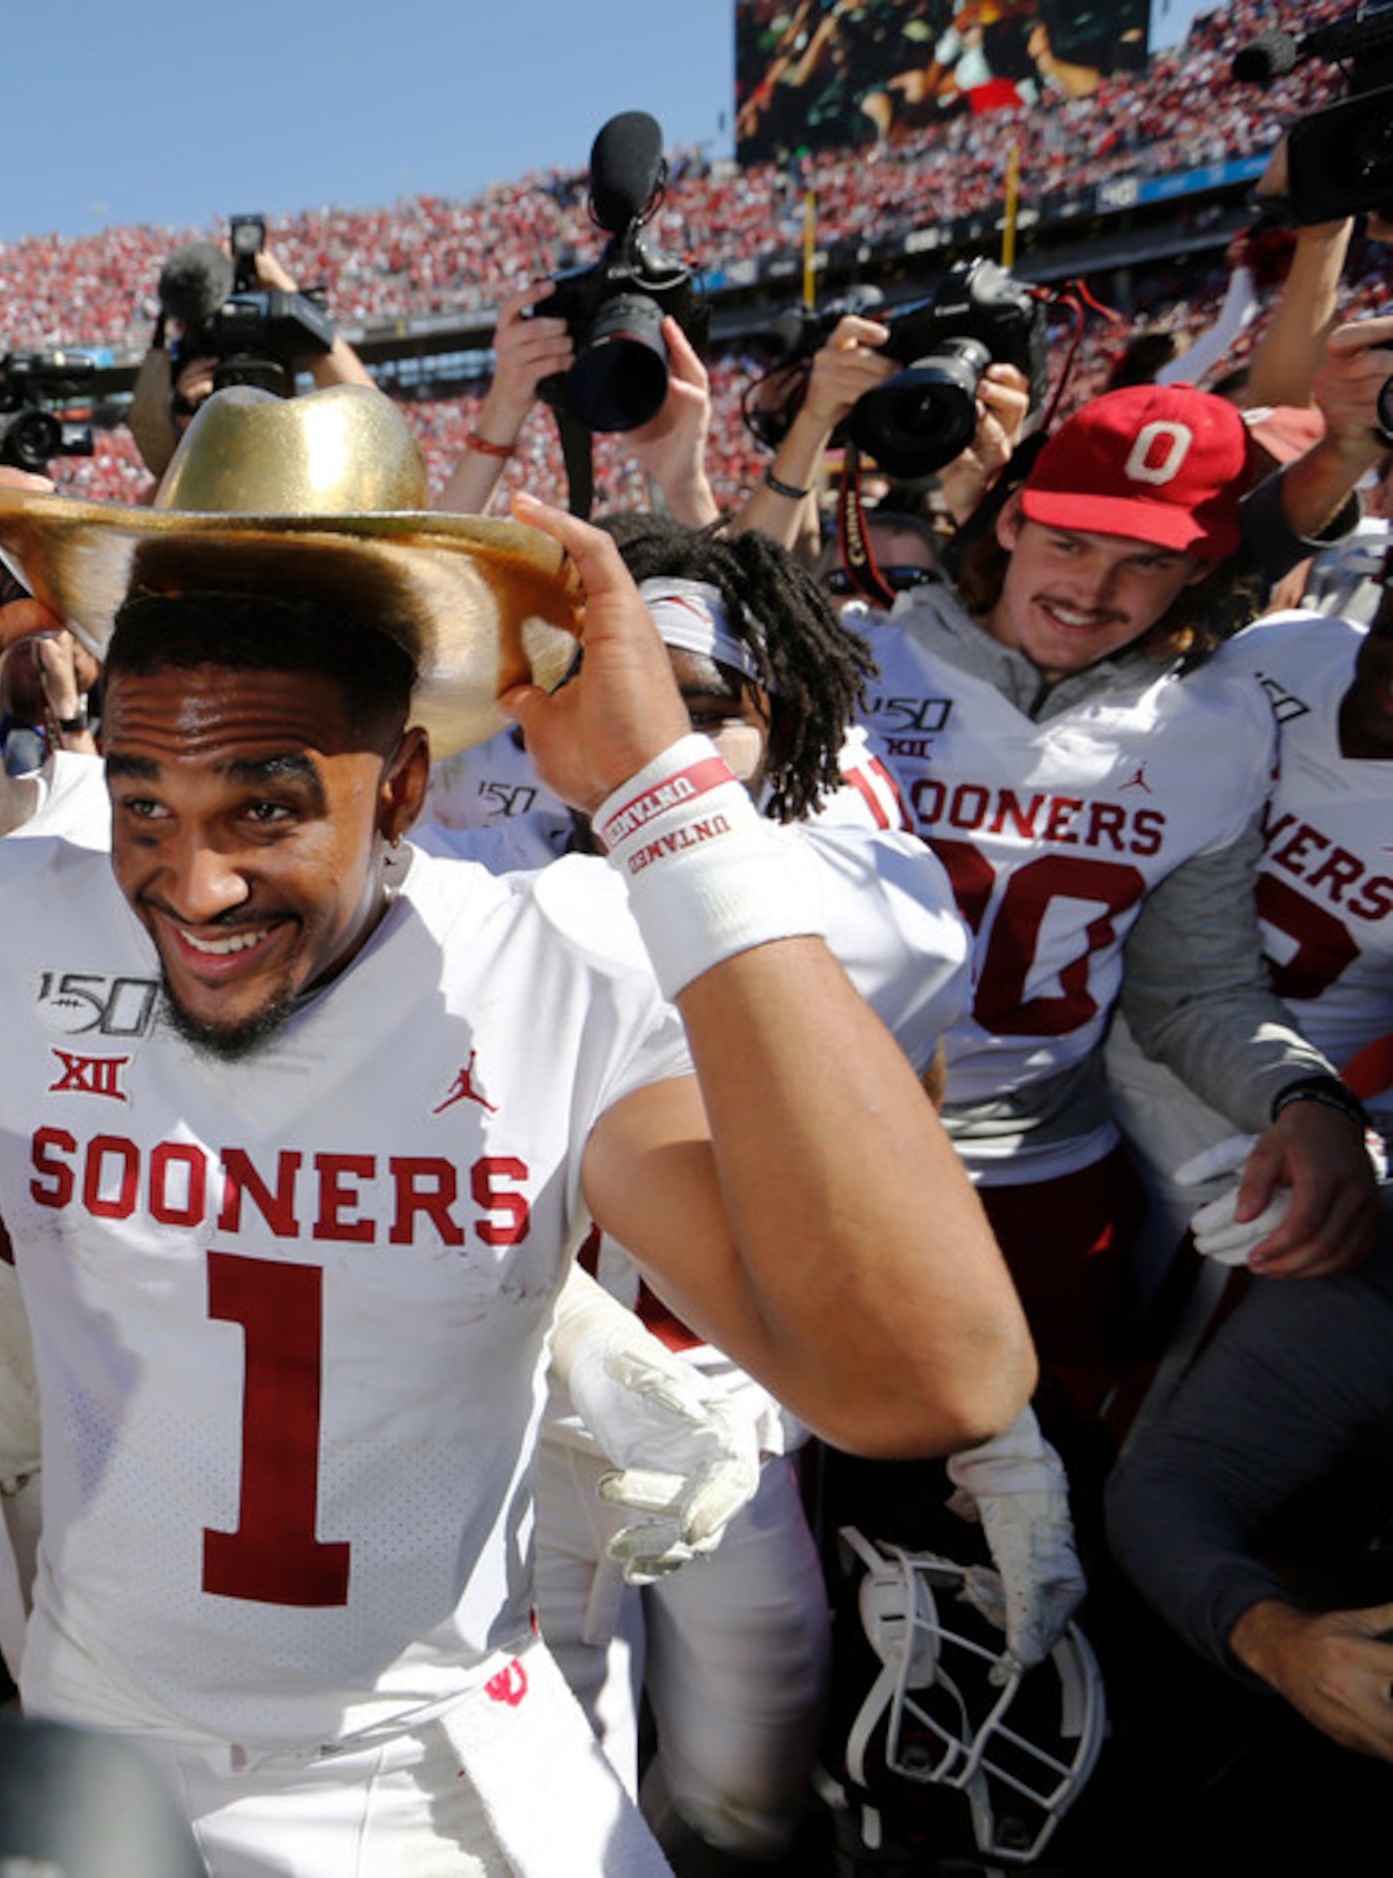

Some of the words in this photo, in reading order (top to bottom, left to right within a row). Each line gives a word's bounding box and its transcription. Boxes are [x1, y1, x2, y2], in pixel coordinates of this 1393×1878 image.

[1125, 420, 1193, 486] O
[628, 814, 733, 875] UNTAMED
[910, 778, 1167, 857] OONERS
[926, 838, 1147, 1037] 0
[37, 971, 160, 1037] 150
[49, 1047, 130, 1102] XII
[29, 1125, 532, 1247] SOONERS
[201, 1250, 350, 1607] 1
